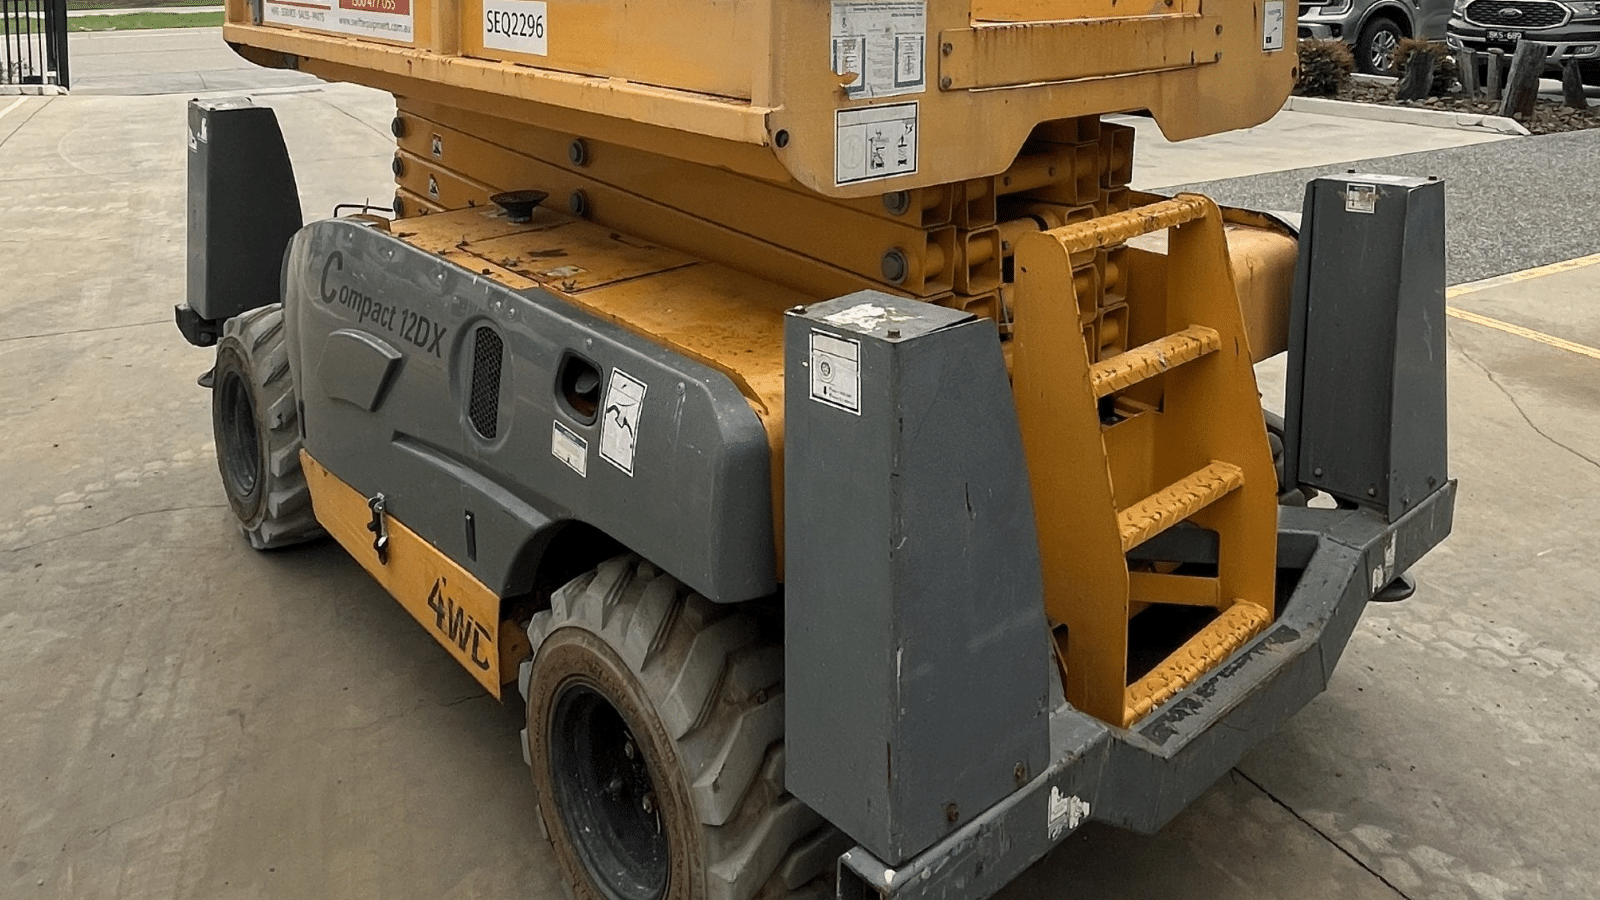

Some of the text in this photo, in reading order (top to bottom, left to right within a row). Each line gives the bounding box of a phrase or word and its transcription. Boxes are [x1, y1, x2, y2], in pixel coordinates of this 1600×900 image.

[486, 10, 544, 39] SEQ2296
[321, 250, 447, 358] Compact 12DX
